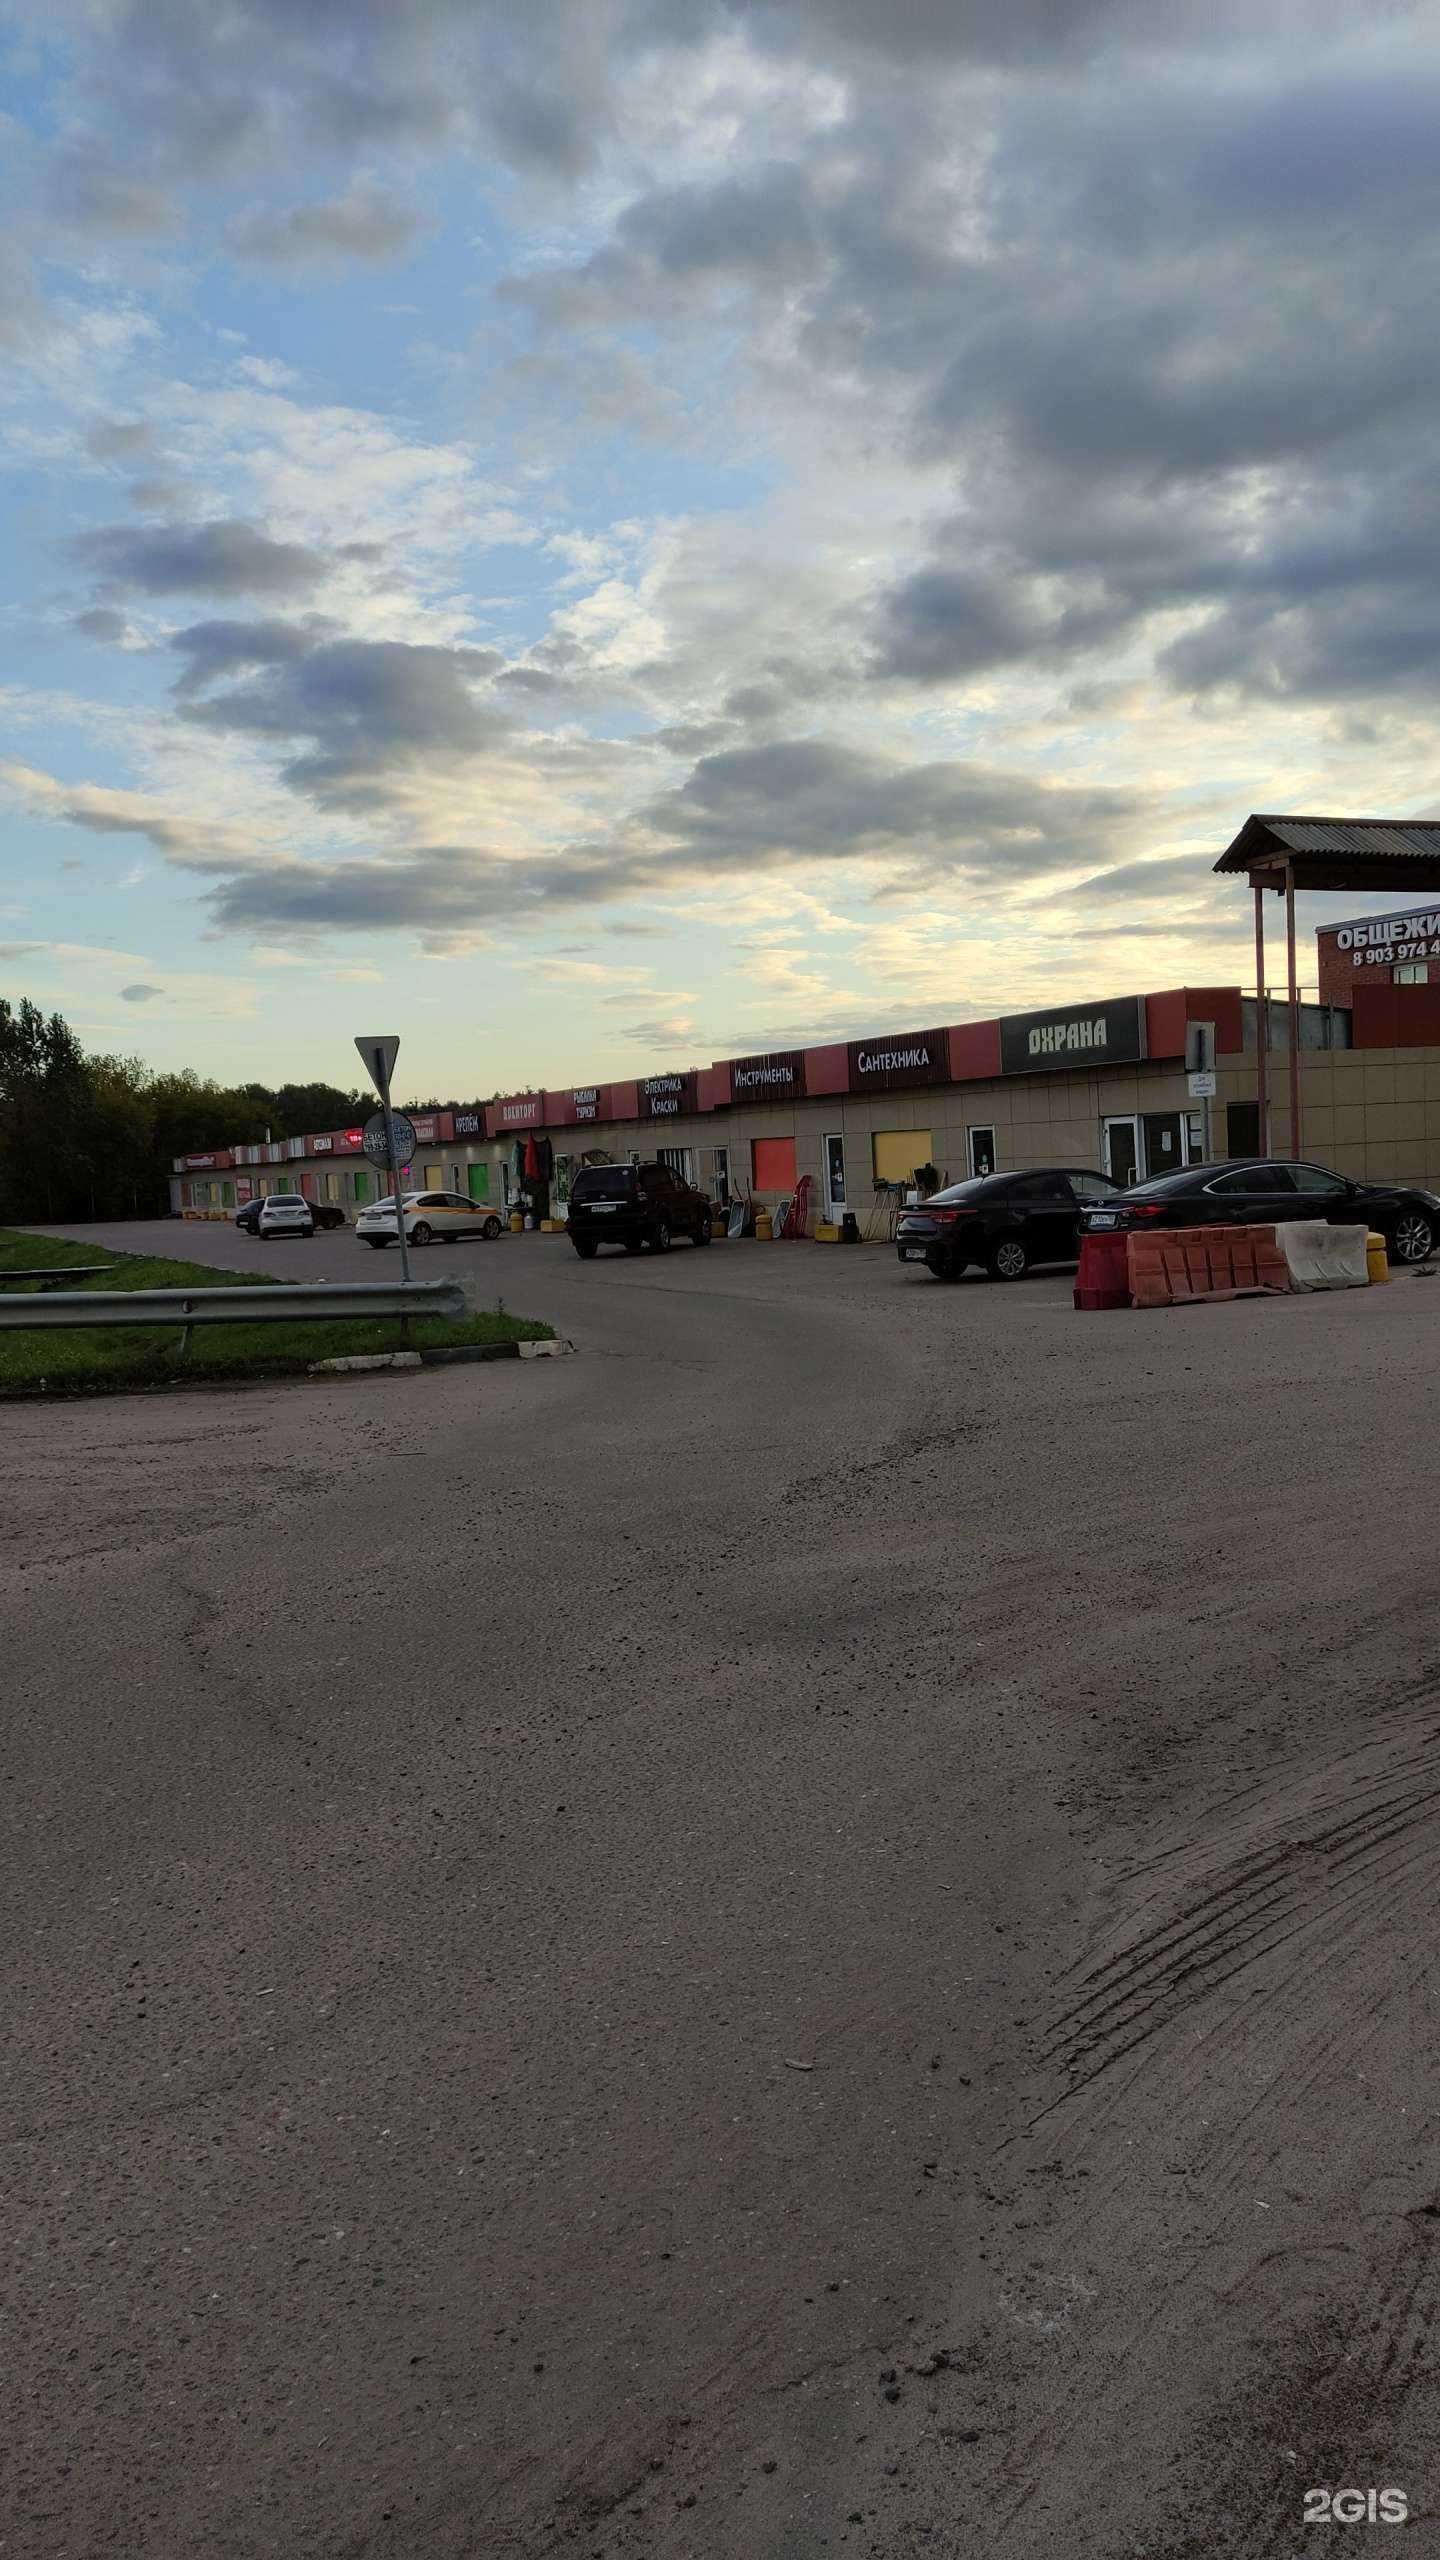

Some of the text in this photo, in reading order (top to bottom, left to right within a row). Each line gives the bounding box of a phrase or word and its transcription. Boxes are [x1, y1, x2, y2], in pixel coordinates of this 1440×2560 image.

[1353, 951, 1362, 966] 8
[1366, 946, 1394, 964] 903
[1397, 941, 1427, 959] 974
[1028, 1017, 1107, 1054] ОХРАНА
[858, 1047, 929, 1073] САНТЕХНИКА
[645, 1077, 682, 1095] ЭЛЕКТРИКА
[734, 1066, 793, 1088] ИНСТРУМЕНТЫ
[651, 1097, 678, 1115] КРАСКИ
